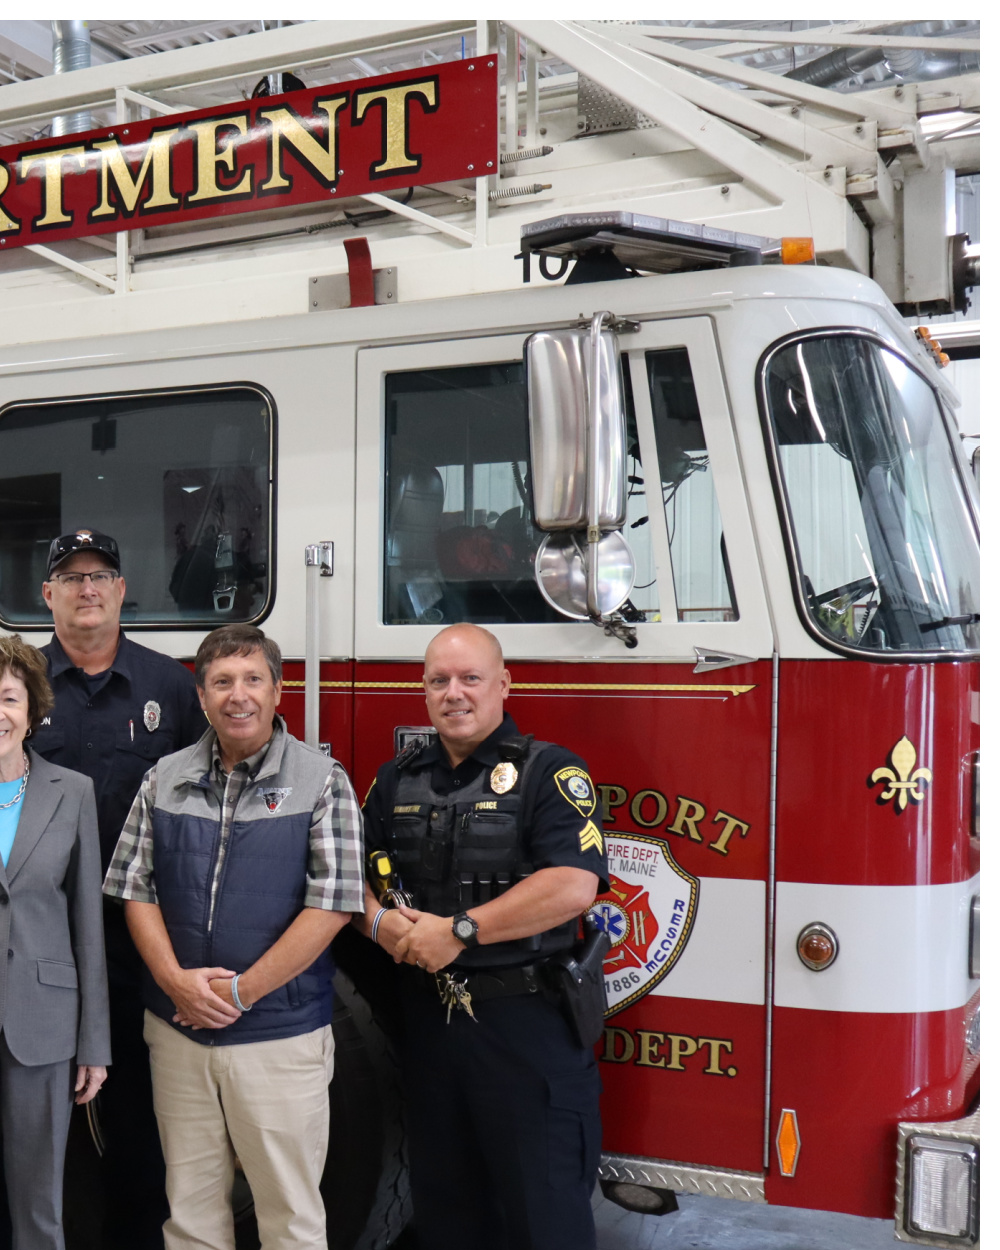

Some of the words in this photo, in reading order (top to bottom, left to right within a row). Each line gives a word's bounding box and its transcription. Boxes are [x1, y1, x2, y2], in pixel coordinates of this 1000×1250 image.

[558, 769, 589, 781] NEWPORT
[475, 801, 498, 811] POLICE
[607, 843, 630, 858] FIRE
[631, 846, 660, 864] DEPT.
[619, 859, 657, 878] MAINE
[645, 899, 685, 973] RESCUE
[604, 971, 640, 993] 1886
[600, 1027, 738, 1078] DEPT.
